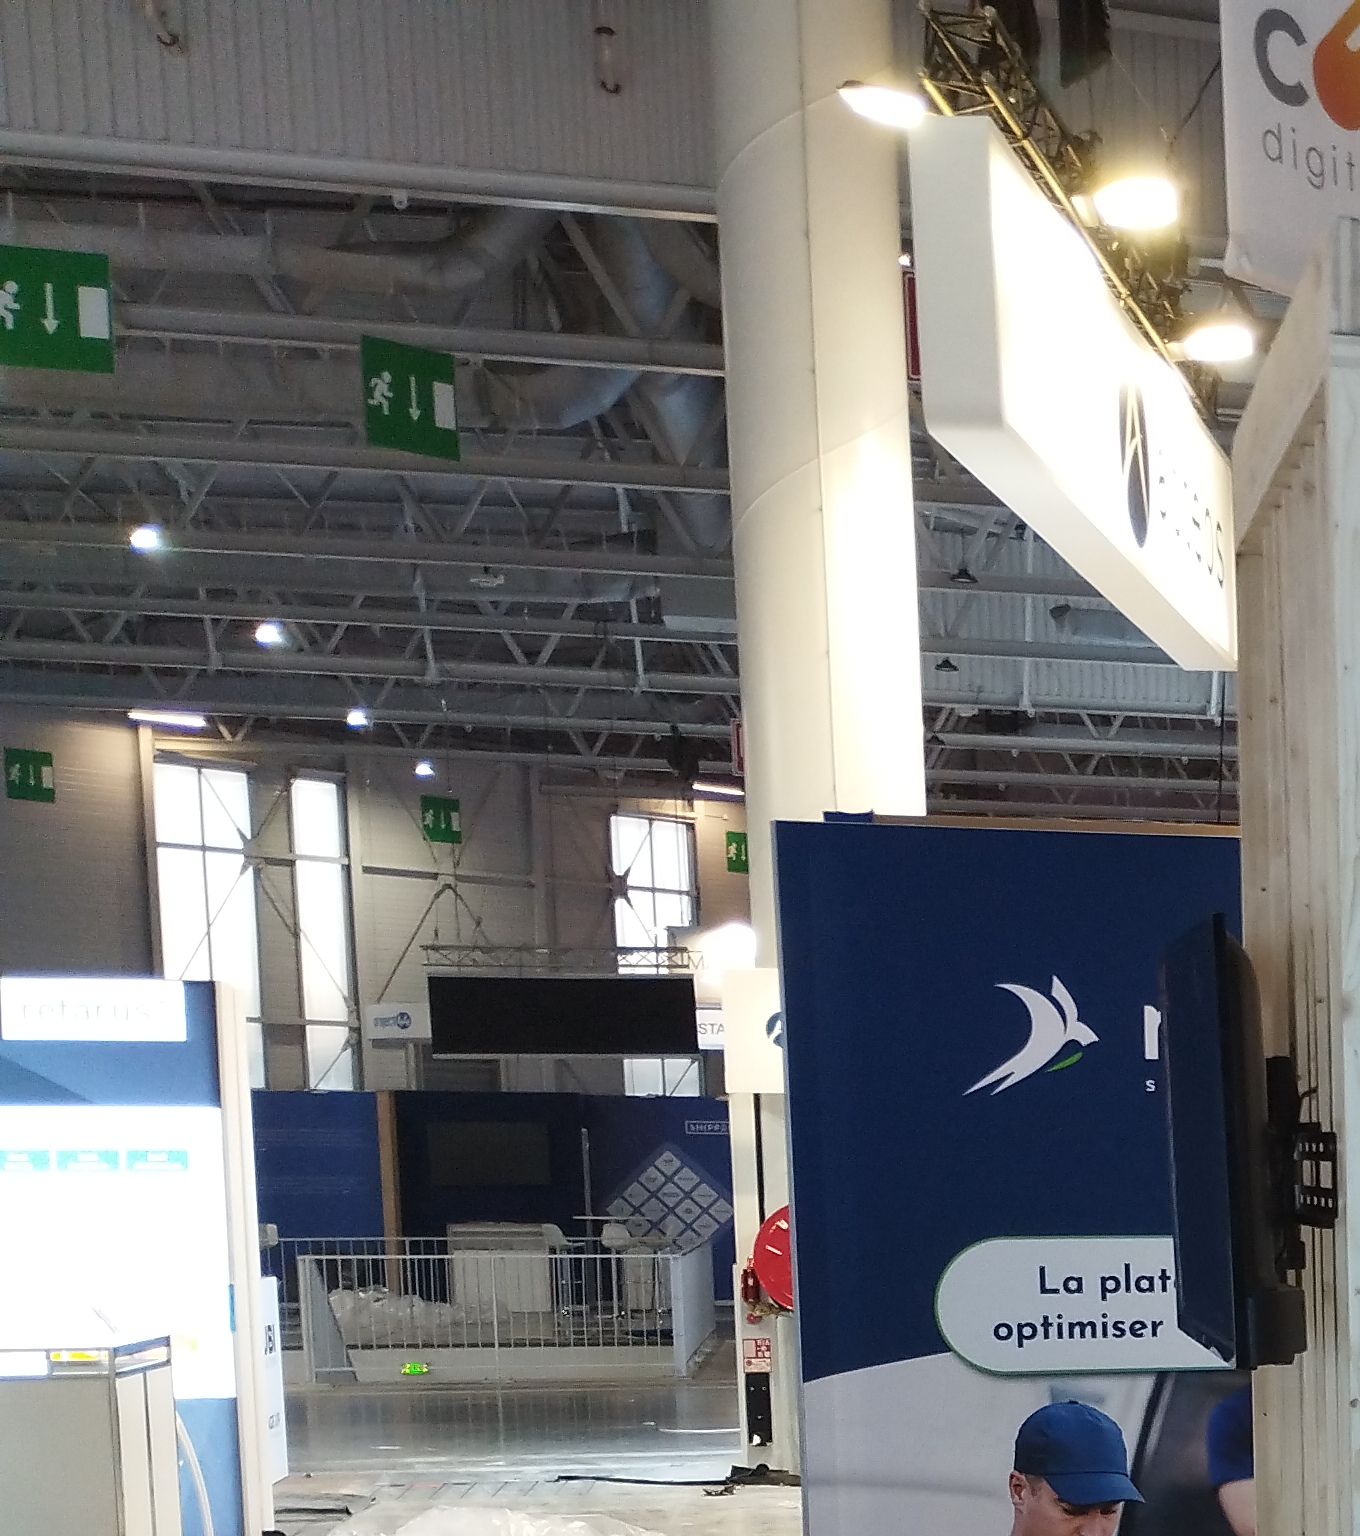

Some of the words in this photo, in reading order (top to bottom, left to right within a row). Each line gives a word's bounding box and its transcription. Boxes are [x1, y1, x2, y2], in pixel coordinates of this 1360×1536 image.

[698, 1023, 725, 1035] STA
[1039, 1265, 1083, 1295] La
[1100, 1263, 1176, 1301] plat
[993, 1312, 1164, 1348] optimiser
